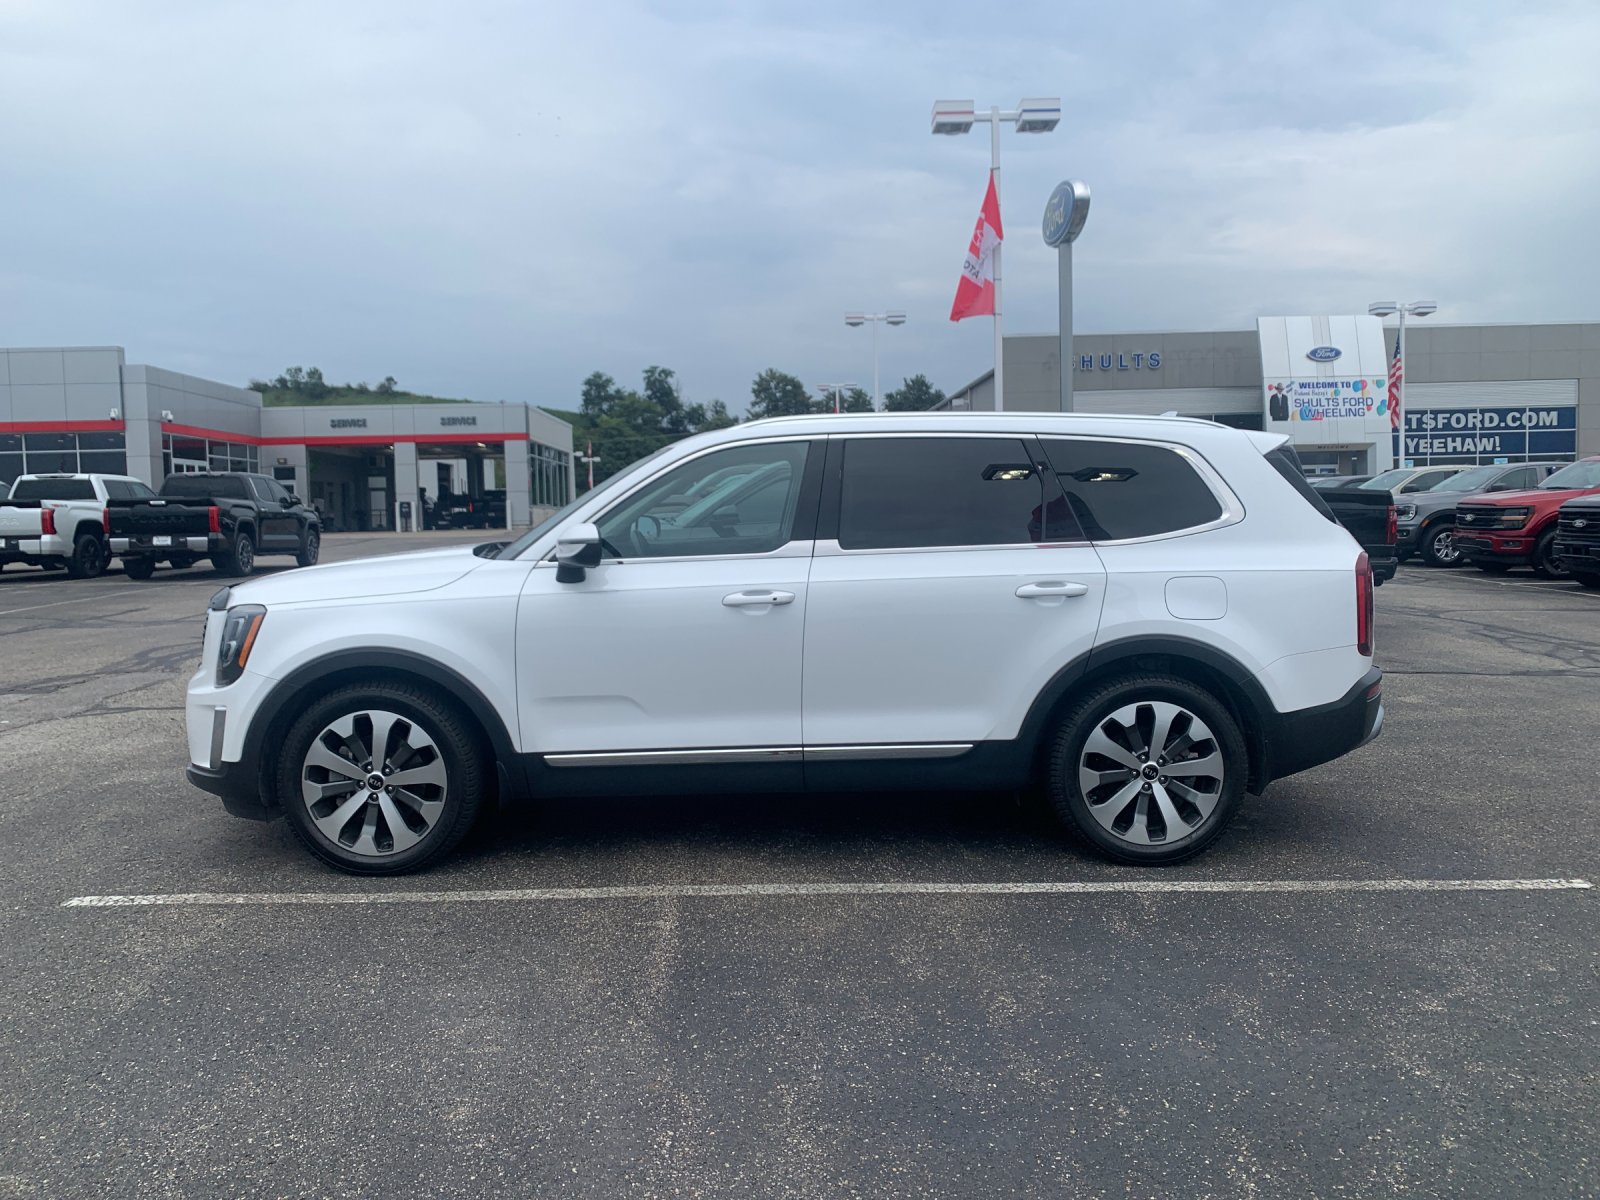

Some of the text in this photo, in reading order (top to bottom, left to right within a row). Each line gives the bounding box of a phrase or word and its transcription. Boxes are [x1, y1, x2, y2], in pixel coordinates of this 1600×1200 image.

[963, 260, 980, 279] OTA
[1073, 351, 1162, 370] HULTS
[1294, 397, 1374, 408] SHULTS FORD
[1303, 408, 1366, 418] WHEELING
[330, 418, 368, 429] SERVICE
[440, 416, 477, 426] SERVICE
[1405, 411, 1558, 429] TSFORD.COM
[1405, 436, 1501, 453] YEEHAW!
[1145, 767, 1157, 778] KIA
[369, 777, 382, 788] KIA
